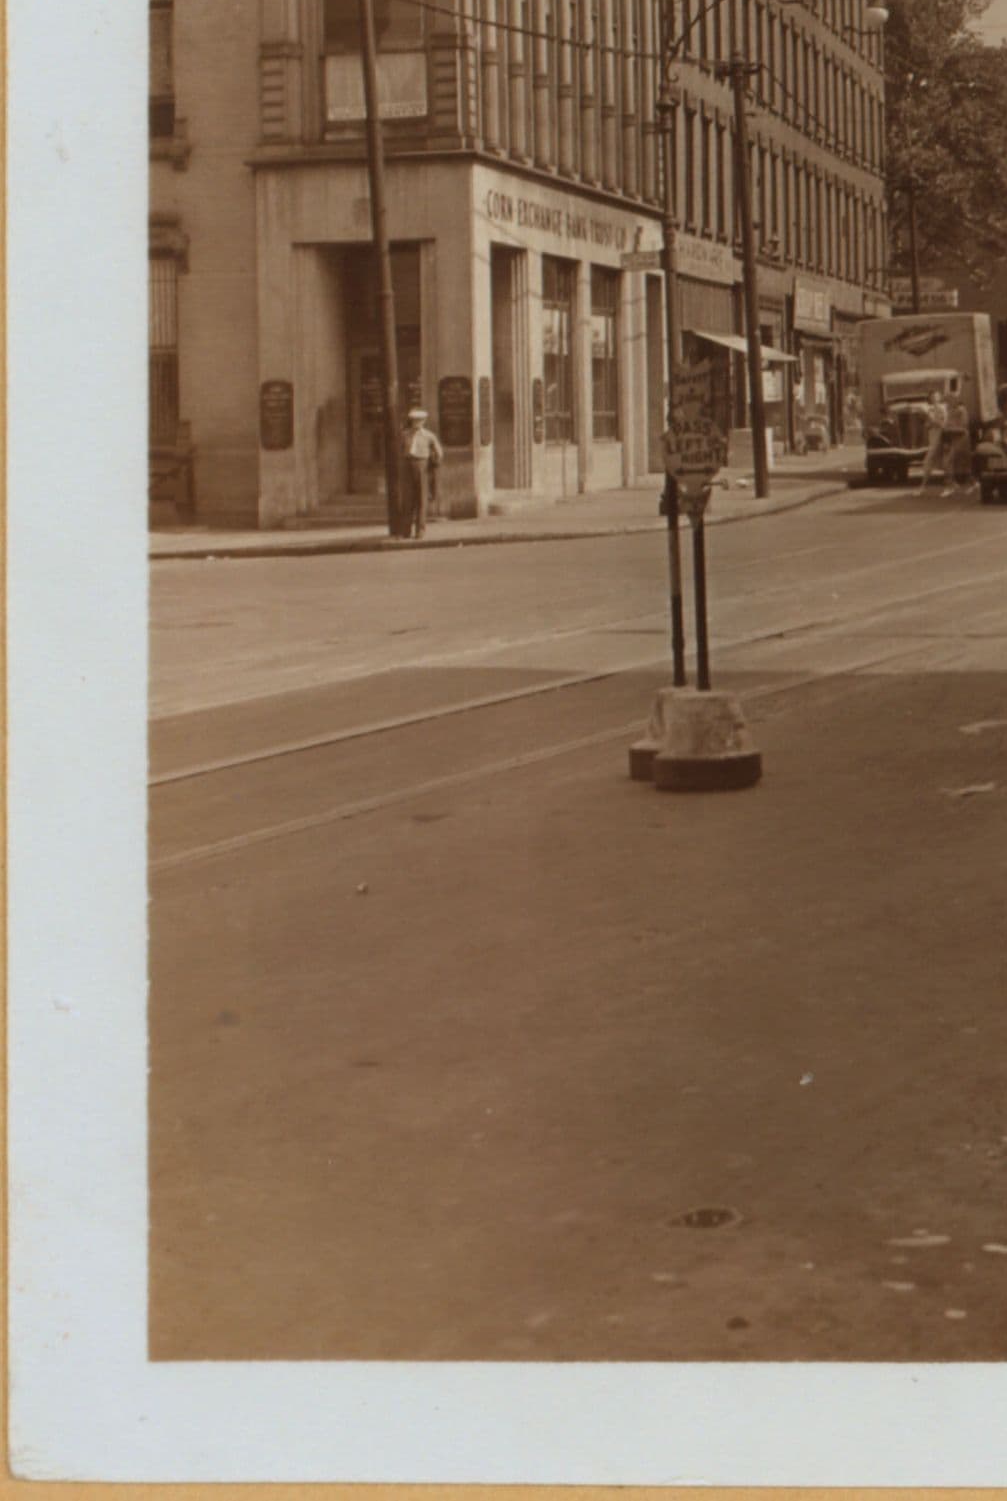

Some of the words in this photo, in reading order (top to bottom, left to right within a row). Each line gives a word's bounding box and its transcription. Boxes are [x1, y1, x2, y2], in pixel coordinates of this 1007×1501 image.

[486, 189, 513, 221] CORN
[517, 197, 562, 237] EXCHANGE
[565, 211, 588, 242] BANK
